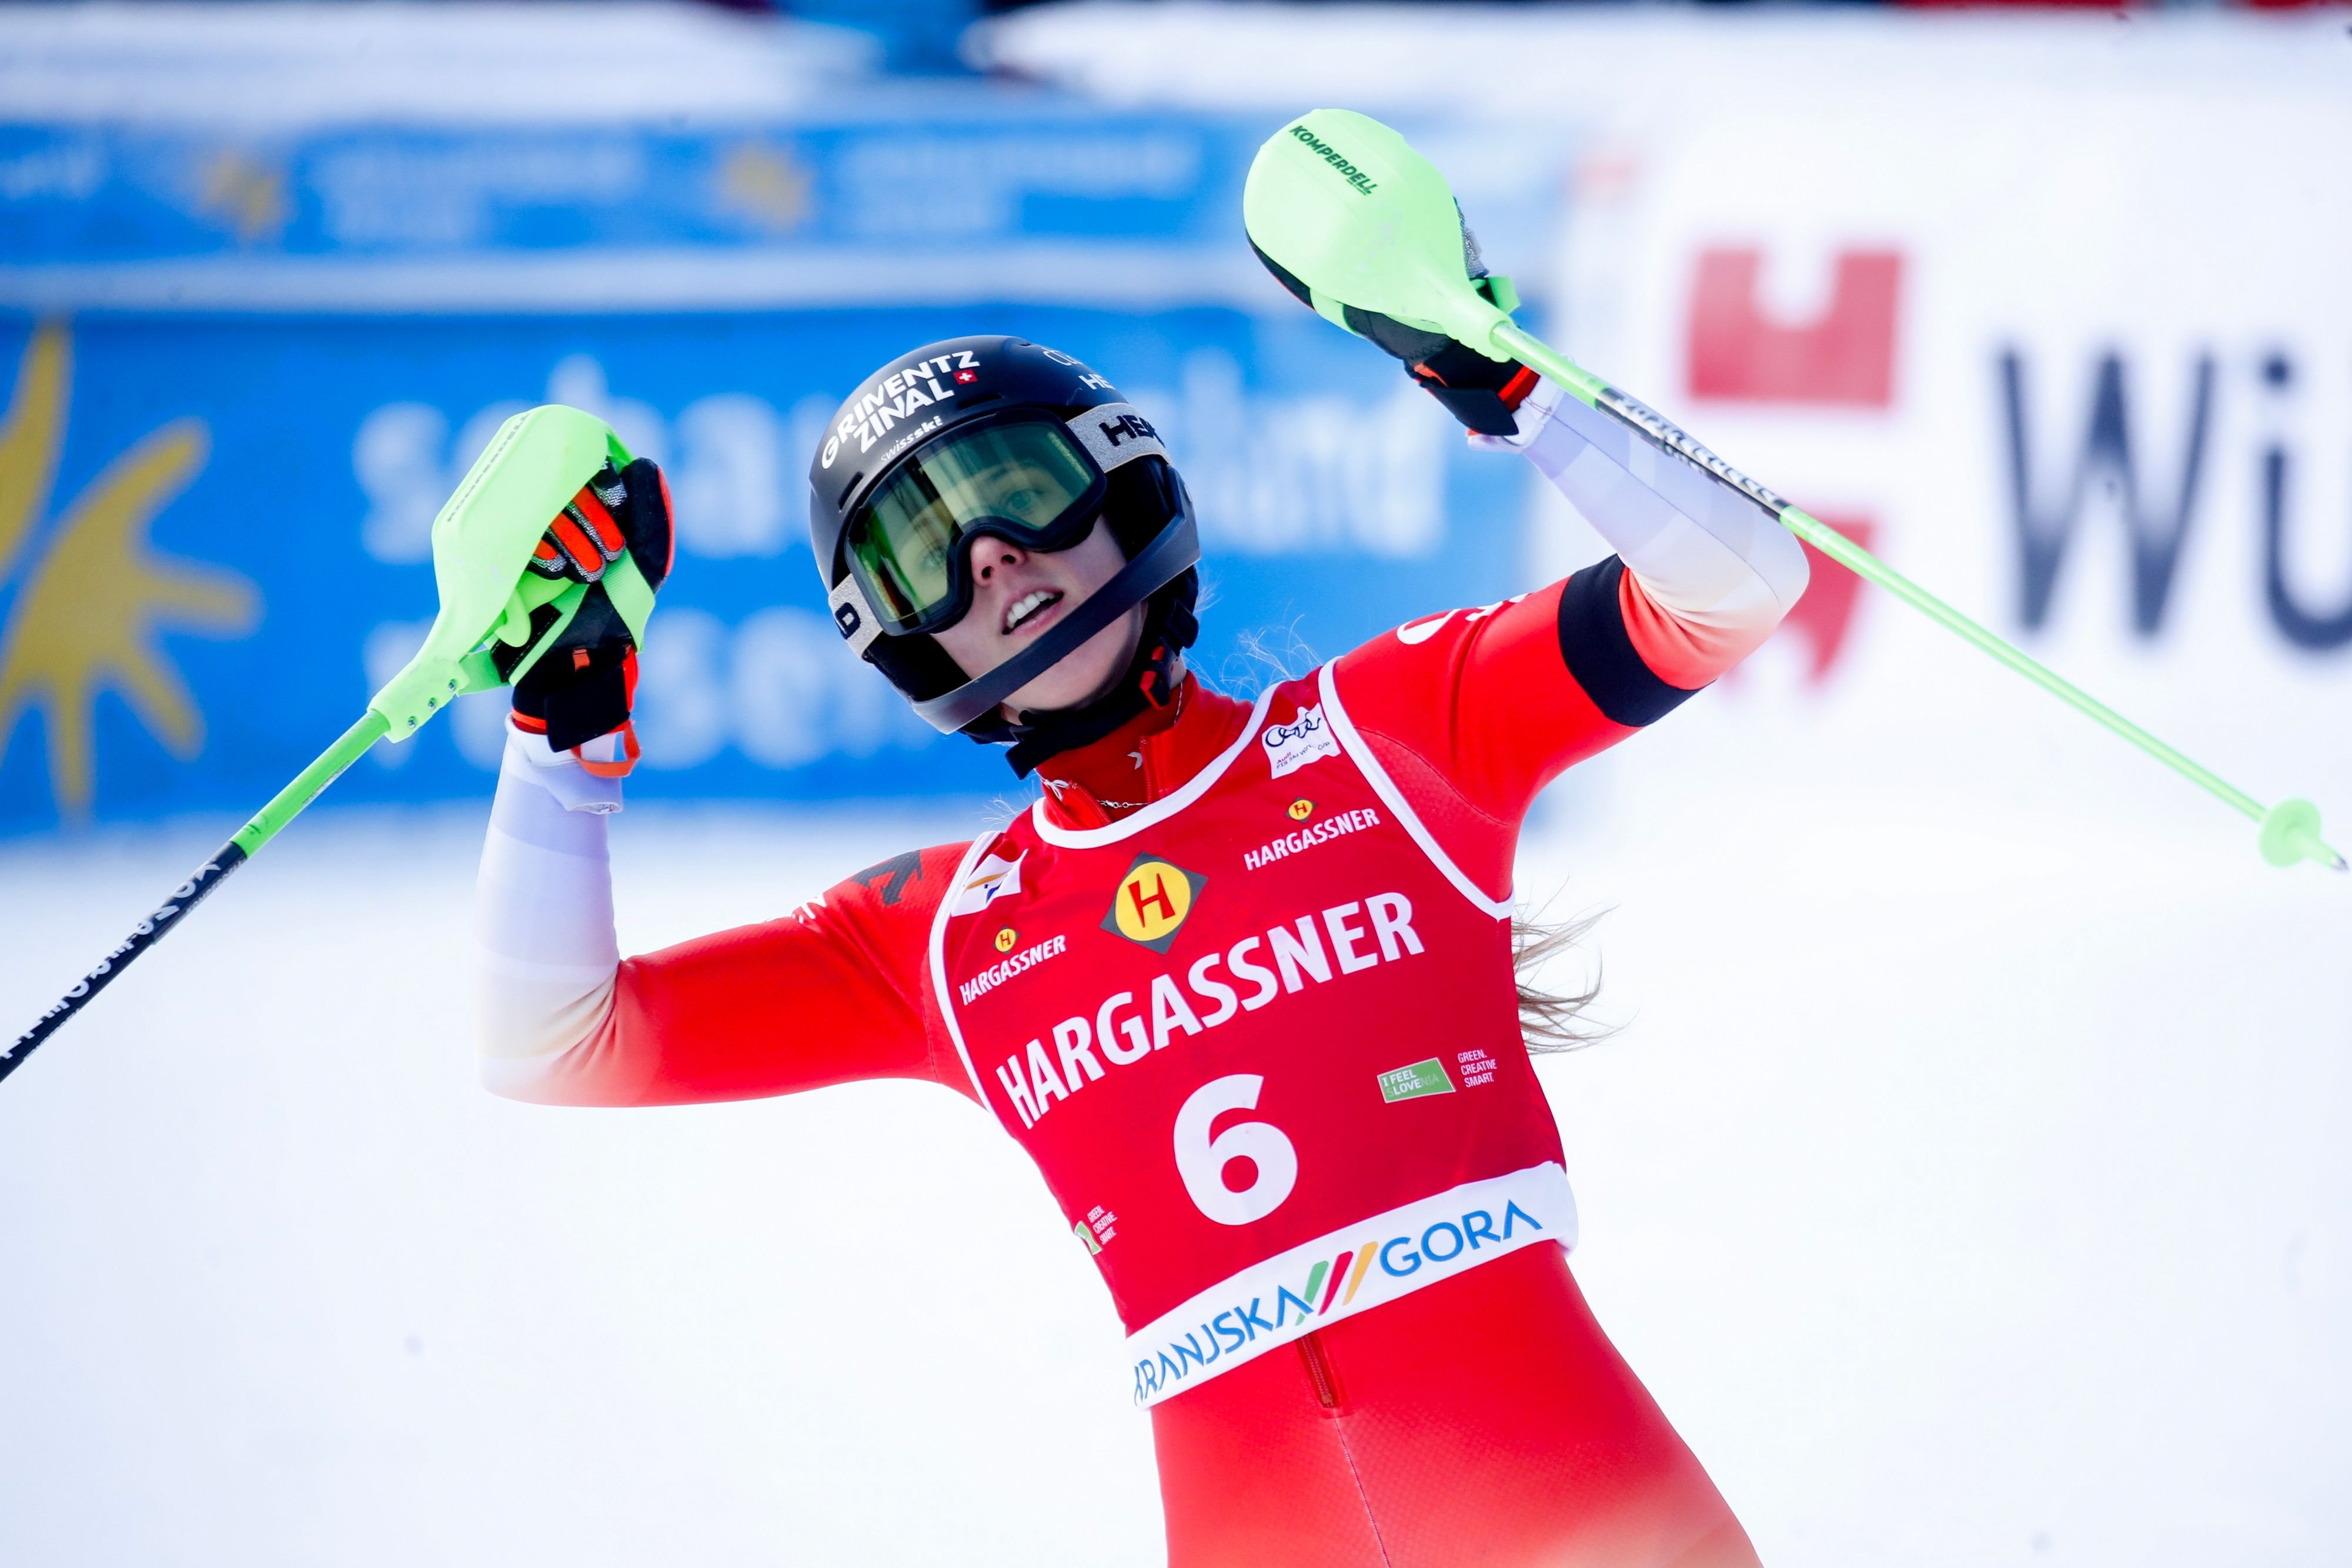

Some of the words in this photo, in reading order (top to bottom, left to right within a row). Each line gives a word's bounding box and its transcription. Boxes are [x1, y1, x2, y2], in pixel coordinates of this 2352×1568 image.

[1288, 125, 1378, 196] KOMPERDELL
[821, 350, 980, 469] GRIMENTZ
[853, 378, 955, 454] ZINAL
[880, 415, 943, 463] swissski
[1277, 751, 1291, 764] Audi
[1294, 803, 1308, 816] H
[1244, 808, 1381, 871] HARGASSNER
[1127, 872, 1176, 928] H
[999, 931, 1011, 948] H
[958, 934, 1067, 1007] HARGASSNER
[995, 891, 1425, 1130] HARGASSNER
[1389, 1069, 1417, 1085] FEEL
[1457, 1049, 1488, 1064] GREEN.
[1460, 1059, 1498, 1076] CREATIVE
[1172, 1073, 1298, 1226] 6
[1379, 1198, 1544, 1278] GORA
